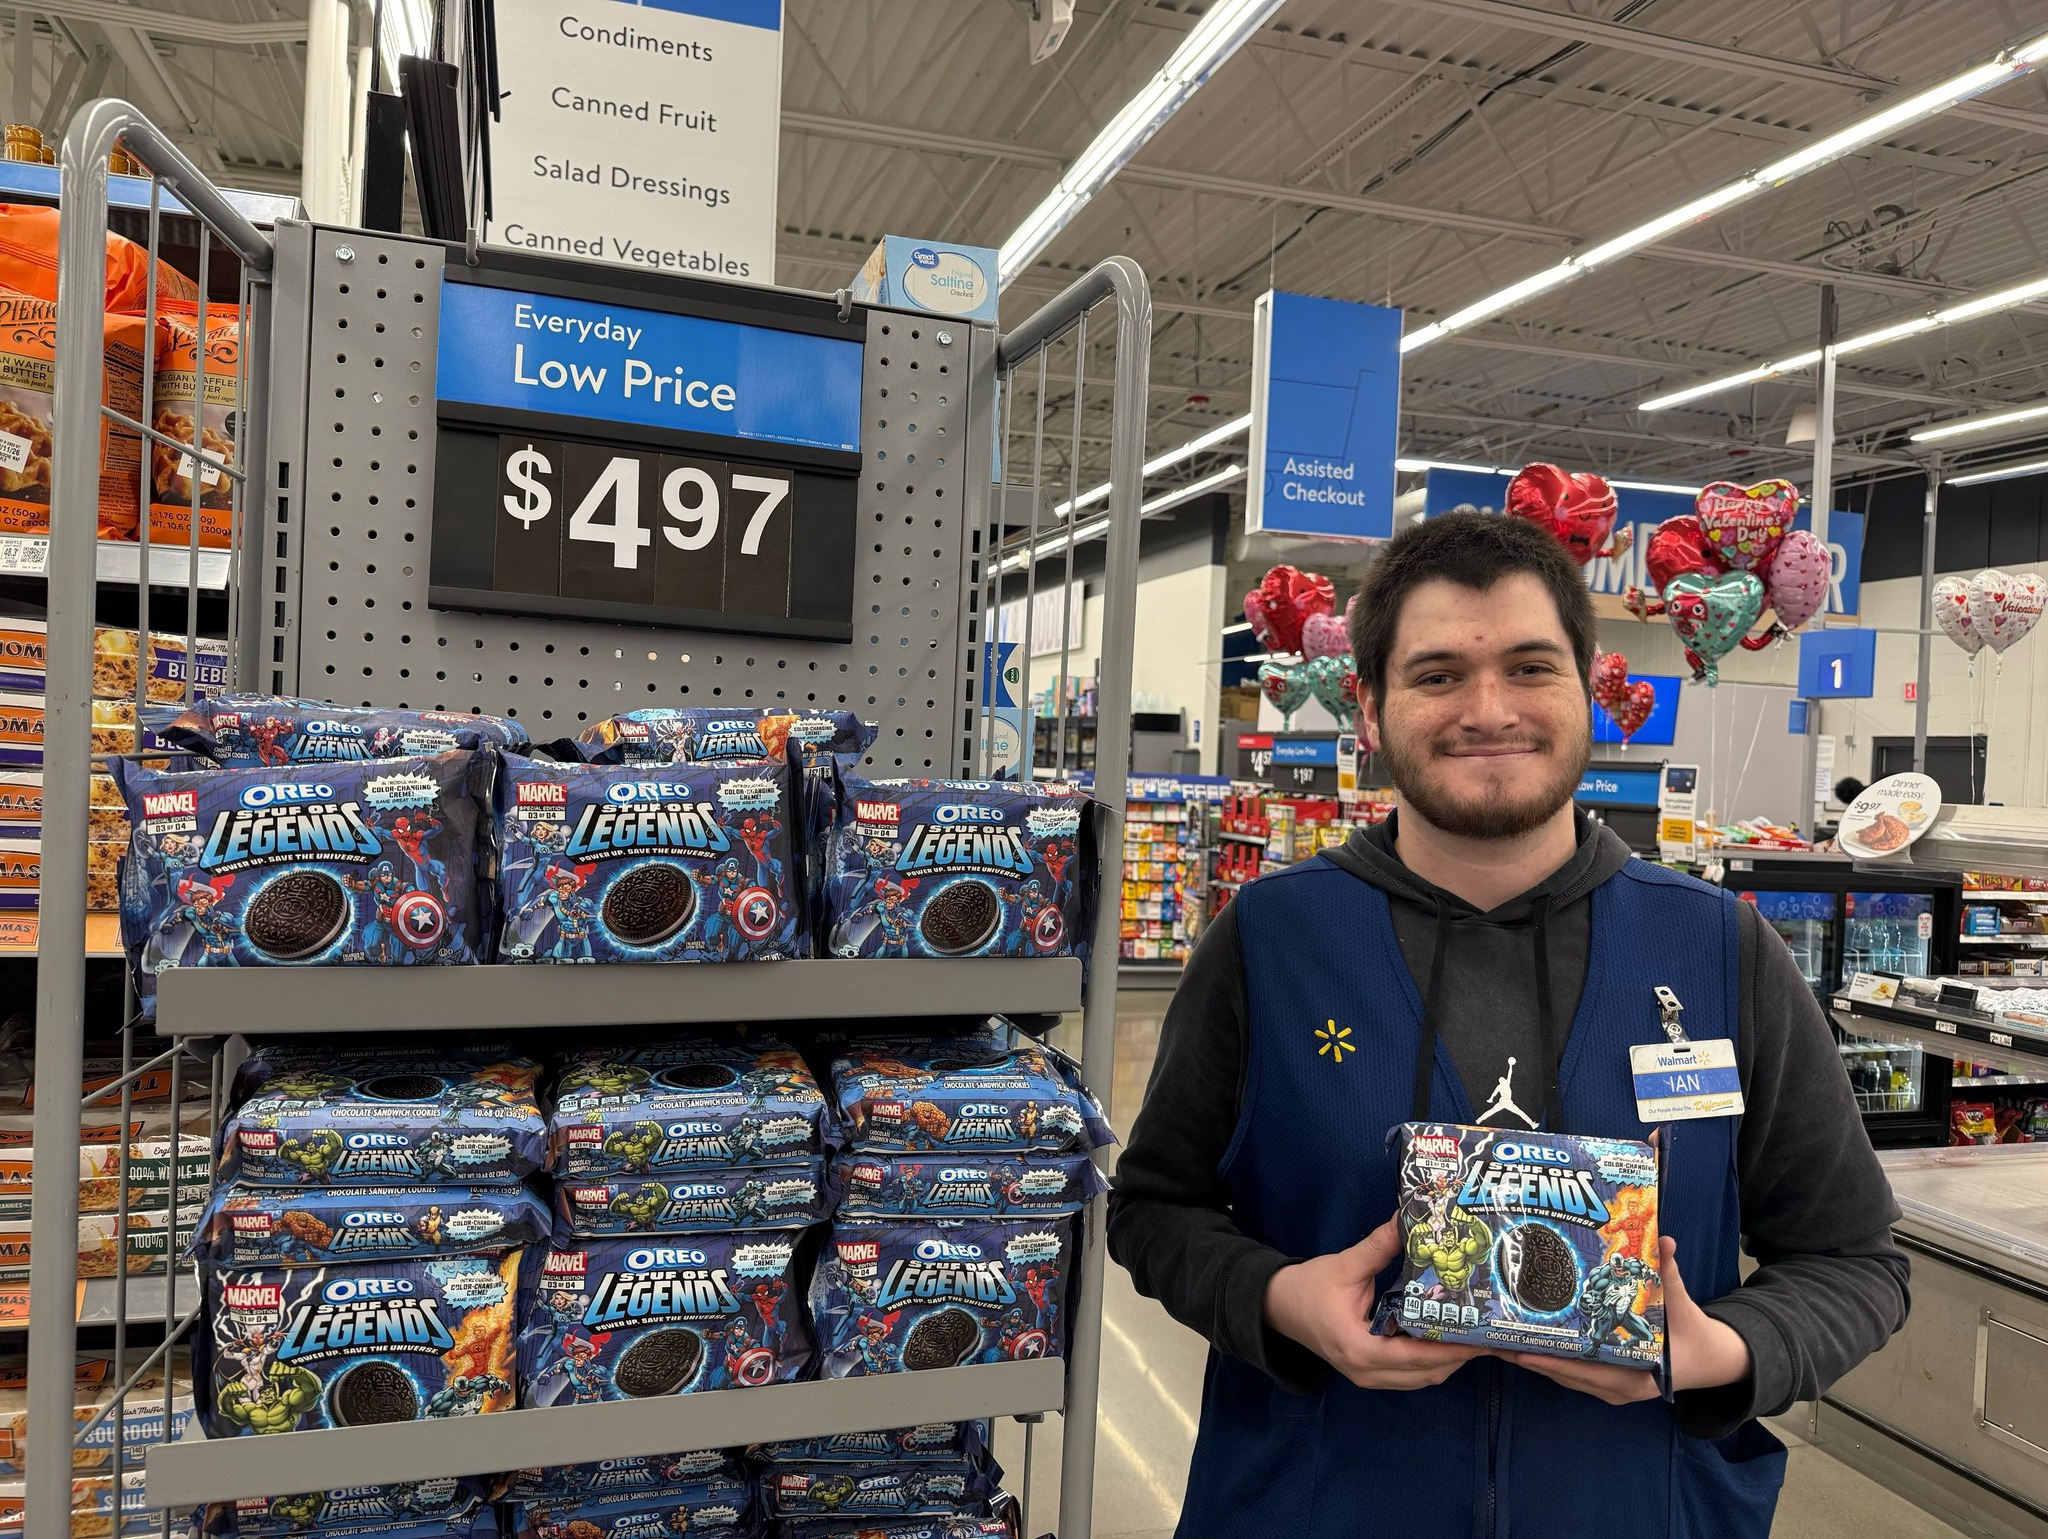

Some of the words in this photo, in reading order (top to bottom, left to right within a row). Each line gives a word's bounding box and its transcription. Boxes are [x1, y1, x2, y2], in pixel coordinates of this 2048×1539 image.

[559, 16, 714, 62] Condiments
[551, 86, 649, 122] Canned
[659, 102, 717, 133] Fruit
[534, 155, 601, 185] Salad
[611, 166, 730, 205] Dressings
[504, 224, 603, 257] Canned
[614, 237, 750, 277] Vegetables
[914, 251, 935, 261] Great
[930, 273, 974, 290] Saltine
[514, 303, 643, 349] Everyday
[3, 365, 46, 380] BUTTER
[13, 358, 54, 373] WAFFL
[161, 382, 180, 390] WITH
[514, 344, 608, 394] Low
[624, 359, 737, 411] Price
[1283, 457, 1355, 482] Assisted
[1282, 482, 1365, 506] Checkout
[1714, 498, 1763, 513] Happy
[159, 511, 173, 519] 1.76
[176, 513, 189, 521] OZ
[1701, 511, 1781, 529] Valentine's
[168, 522, 184, 531] 10.6
[201, 526, 231, 537] (300g)
[1737, 526, 1767, 543] Day
[1831, 658, 1842, 689] 1
[1905, 683, 1917, 699] EX
[306, 721, 362, 735] OREO
[707, 720, 756, 733] OREO
[696, 732, 768, 760] LEGENDS
[607, 782, 691, 803] OREO
[1595, 779, 1618, 793] Price
[1892, 779, 1922, 789] Dinner
[241, 784, 334, 808] OREO
[518, 784, 567, 803] MARVEL
[1876, 788, 1903, 798] made
[1902, 791, 1925, 800] easy.
[145, 792, 196, 816] MARVEL
[236, 807, 306, 820] STUF
[307, 804, 338, 815] OF
[601, 803, 662, 813] STUF
[665, 803, 695, 812] OF
[856, 801, 900, 821] MARVEL
[147, 817, 171, 825] SPECIAL
[171, 814, 196, 823] EDITION
[935, 805, 1005, 823] OREO
[155, 824, 167, 833] 03
[174, 822, 187, 831] 04
[201, 803, 382, 867] LEGENDS
[566, 803, 732, 856] LEGENDS
[928, 824, 981, 834] STUF
[983, 824, 1006, 834] OF
[896, 824, 1035, 874] LEGENDS
[215, 861, 250, 874] POWER
[251, 857, 268, 867] UP.
[268, 854, 294, 863] SAVE
[295, 853, 314, 862] THE
[316, 853, 368, 864] UNIVERSE.
[1658, 1054, 1698, 1067] Walmart
[1670, 1073, 1701, 1093] IAN
[331, 1107, 371, 1118] CHOCOLATE
[371, 1107, 410, 1118] SANDWICH
[411, 1107, 442, 1117] COOKIES
[959, 1104, 1009, 1118] OREO
[1657, 1106, 1672, 1114] People
[1694, 1098, 1734, 1112] Difference
[667, 1122, 722, 1137] OREO
[945, 1117, 1017, 1142] LEGENDS
[239, 1132, 276, 1148] MARVEL
[347, 1133, 409, 1149] OREO
[1415, 1135, 1458, 1155] MARVEL
[651, 1135, 734, 1164] LEGENDS
[1494, 1142, 1571, 1165] OREO
[333, 1148, 423, 1175] LEGENDS
[1424, 1160, 1434, 1168] 01
[1440, 1161, 1450, 1169] 04
[1438, 1155, 1458, 1163] EDITION
[1487, 1162, 1543, 1176] STUF
[1549, 1166, 1575, 1178] OF
[1456, 1160, 1611, 1223] LEGENDS
[232, 1214, 272, 1229] MARVEL
[343, 1211, 406, 1227] OREO
[1511, 1206, 1532, 1215] SAVE
[1533, 1208, 1550, 1217] THE
[1550, 1210, 1596, 1228] UNIVERSE.
[135, 1235, 163, 1249] 100%
[329, 1226, 421, 1252] LEGENDS
[837, 1243, 880, 1261] MARVEL
[915, 1240, 983, 1259] OREO
[626, 1249, 707, 1270] OREO
[325, 1278, 414, 1301] OREO
[878, 1260, 1018, 1308] LEGENDS
[226, 1286, 280, 1307] MARVEL
[583, 1270, 741, 1325] LEGENDS
[1406, 1298, 1420, 1309] 140
[278, 1298, 455, 1359] LEGENDS
[1413, 1321, 1435, 1330] APPEARS
[1434, 1325, 1449, 1333] WHEN
[1485, 1331, 1521, 1343] CHOCOLATE
[1521, 1336, 1556, 1348] SANDWICH
[1556, 1340, 1583, 1352] COOKIES
[1639, 1340, 1651, 1350] NET
[1613, 1347, 1632, 1359] 10.68
[1632, 1350, 1642, 1360] OZ
